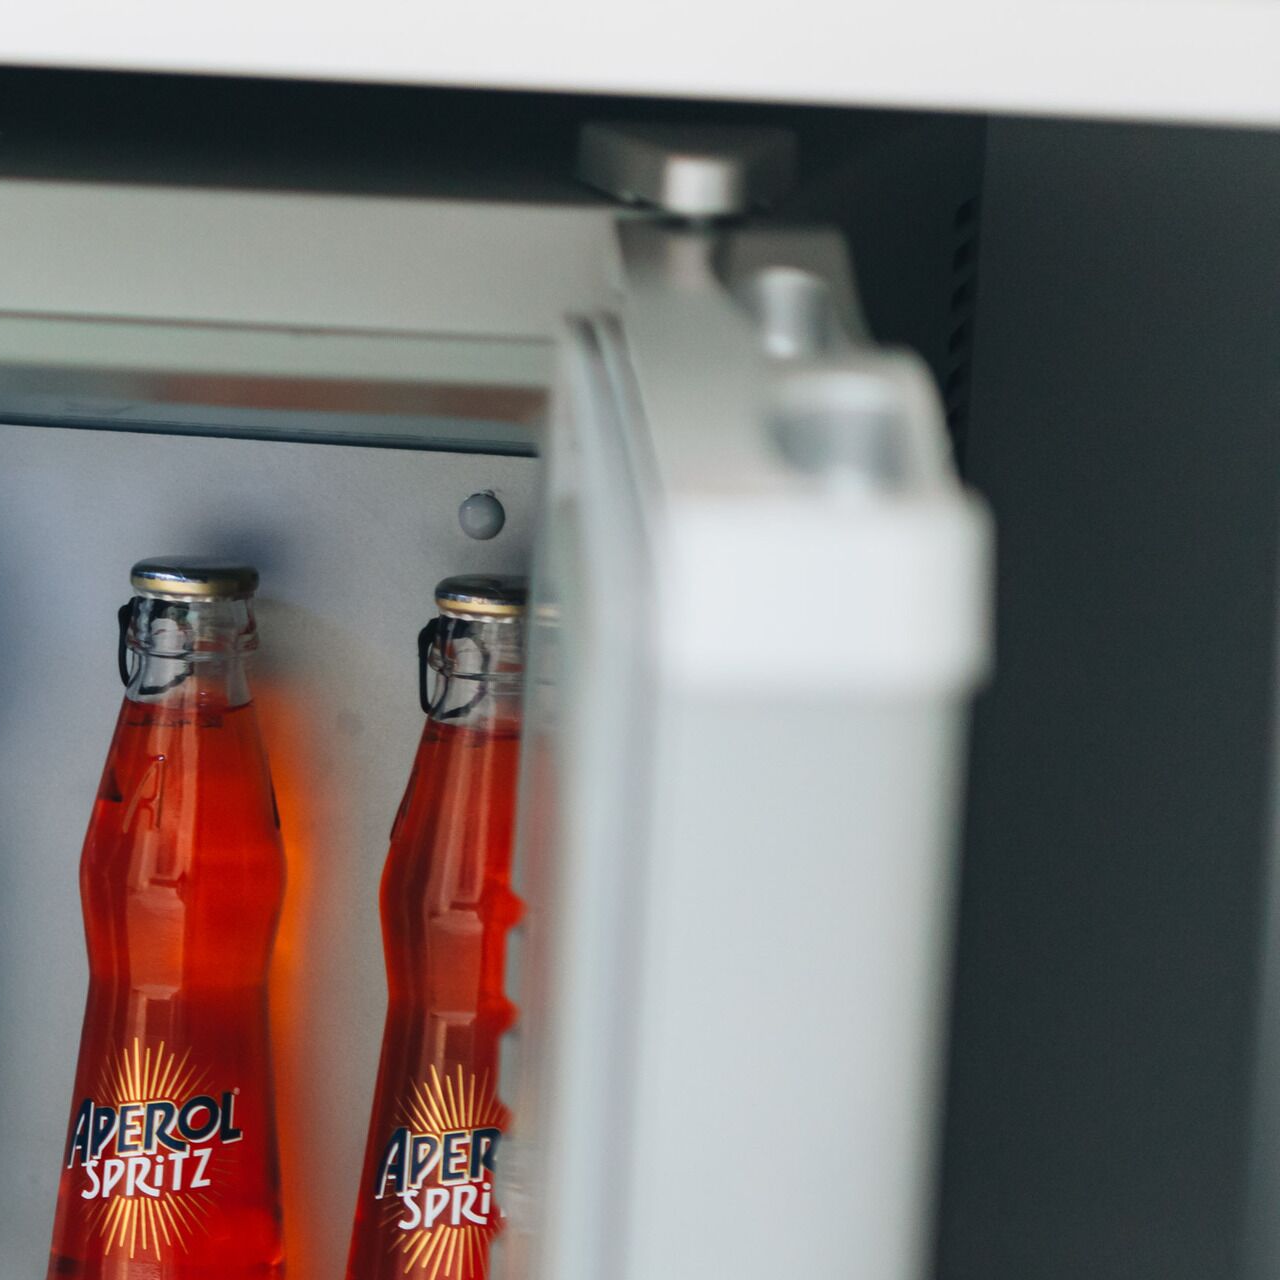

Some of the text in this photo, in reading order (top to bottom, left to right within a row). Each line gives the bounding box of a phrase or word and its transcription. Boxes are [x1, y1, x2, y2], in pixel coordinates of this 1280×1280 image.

[67, 1091, 244, 1169] APEROL
[375, 1127, 502, 1199] APER
[398, 1182, 491, 1230] SPRi
